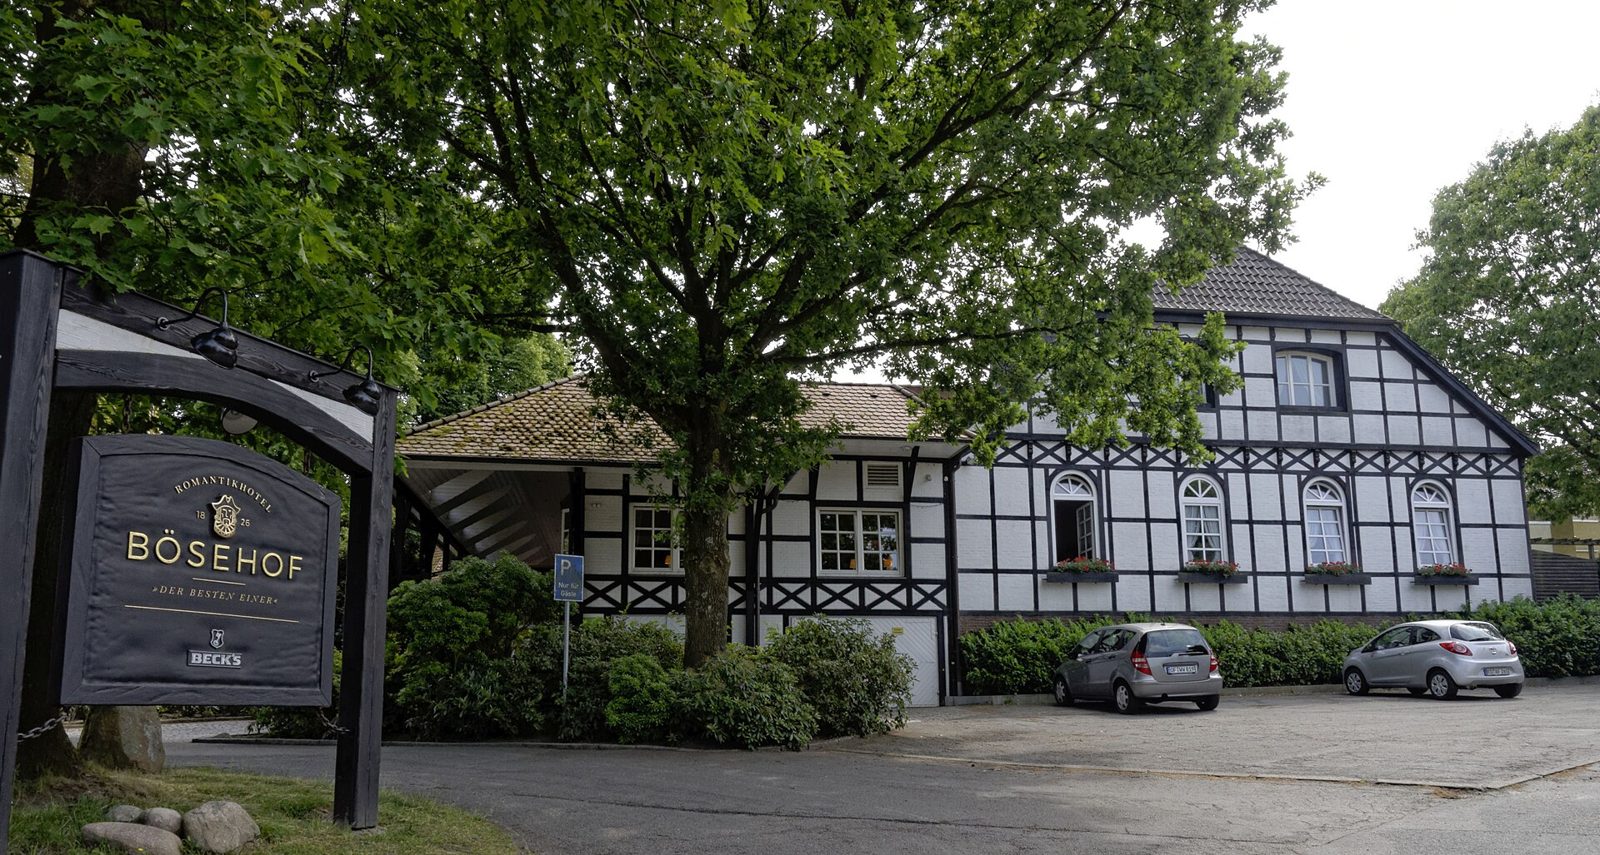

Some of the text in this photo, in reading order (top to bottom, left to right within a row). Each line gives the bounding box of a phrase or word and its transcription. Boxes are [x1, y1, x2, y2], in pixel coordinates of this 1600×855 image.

[174, 475, 272, 513] ROMANTIKHOTEL
[196, 510, 251, 527] 18 26
[127, 528, 303, 580] BÖSEHOF
[561, 559, 571, 576] P
[189, 588, 236, 600] BESTEN
[191, 653, 242, 666] BECK'S
